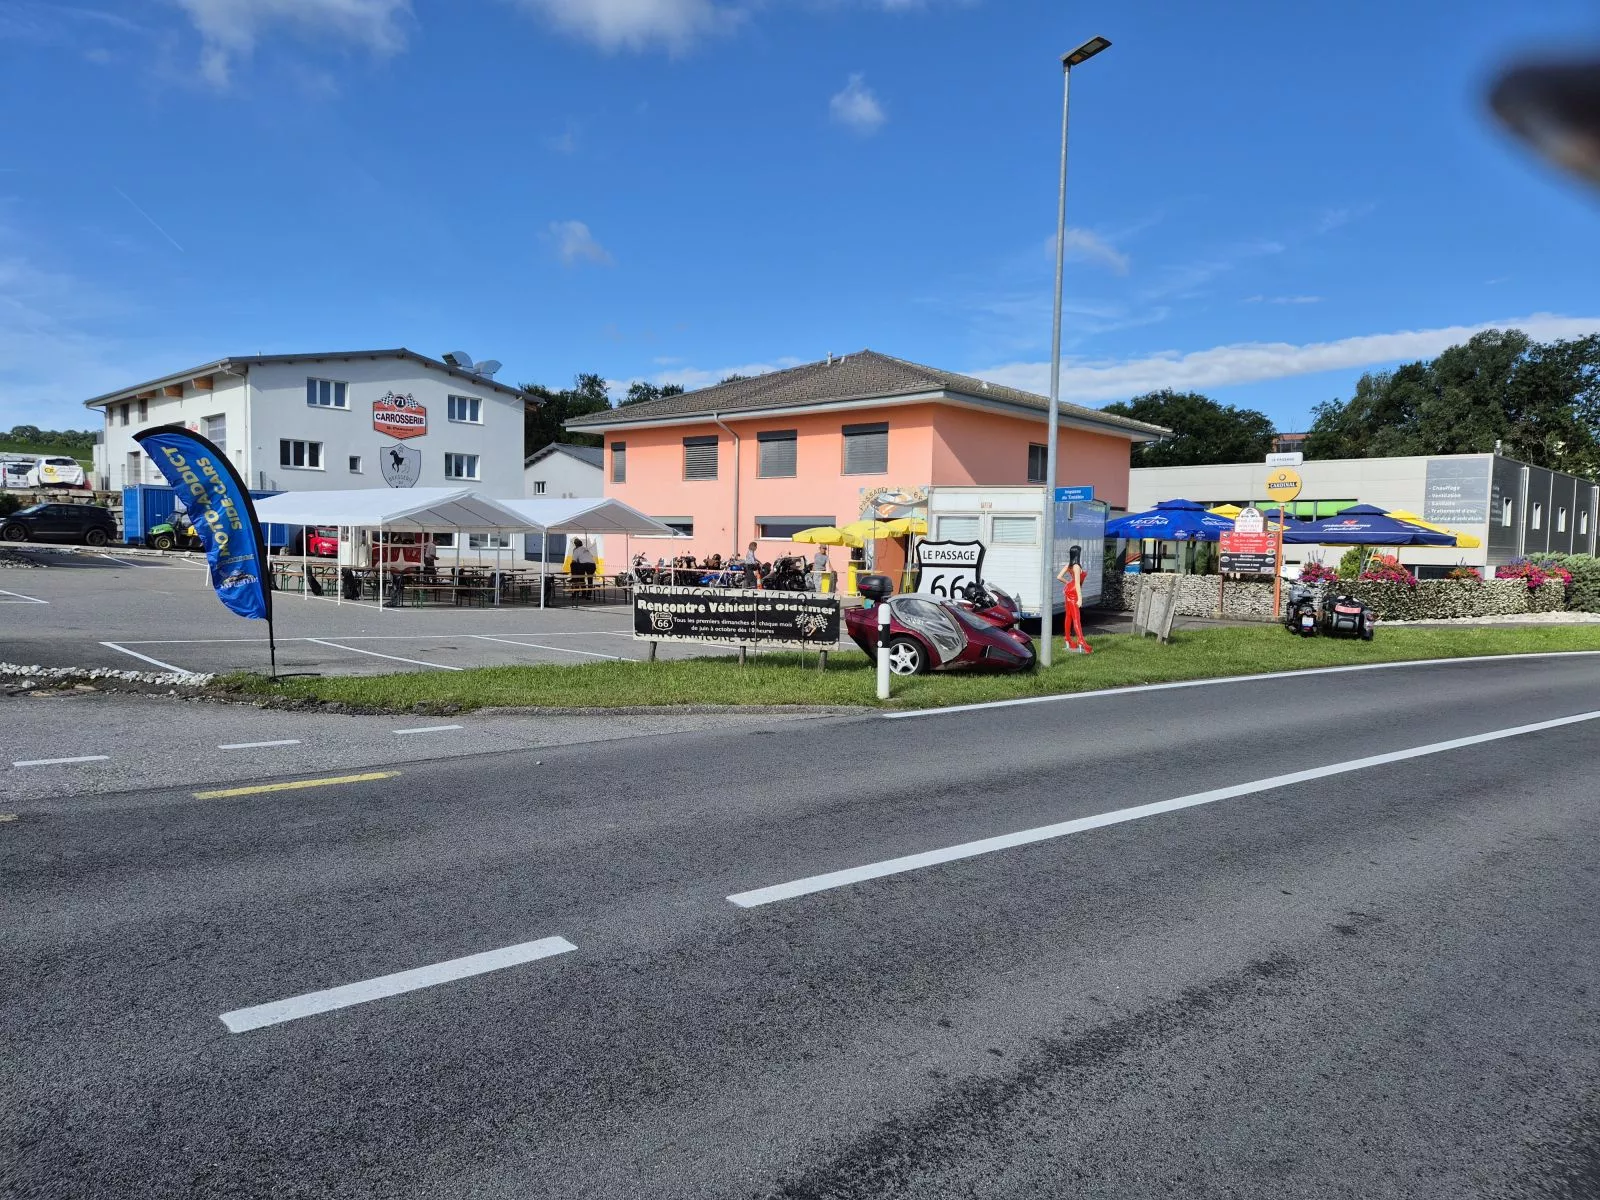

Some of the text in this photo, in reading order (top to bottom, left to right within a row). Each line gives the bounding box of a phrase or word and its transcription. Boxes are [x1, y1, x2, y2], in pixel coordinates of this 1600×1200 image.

[375, 413, 424, 425] CARROSSERIE
[196, 457, 243, 531] SIDE-CARS
[161, 446, 231, 557] MOTO-ADDICT
[922, 550, 976, 561] LE PASSAGE
[637, 599, 836, 615] Rencontre Véhicules Oldtimer
[657, 619, 669, 628] 66
[721, 618, 749, 626] dimanches
